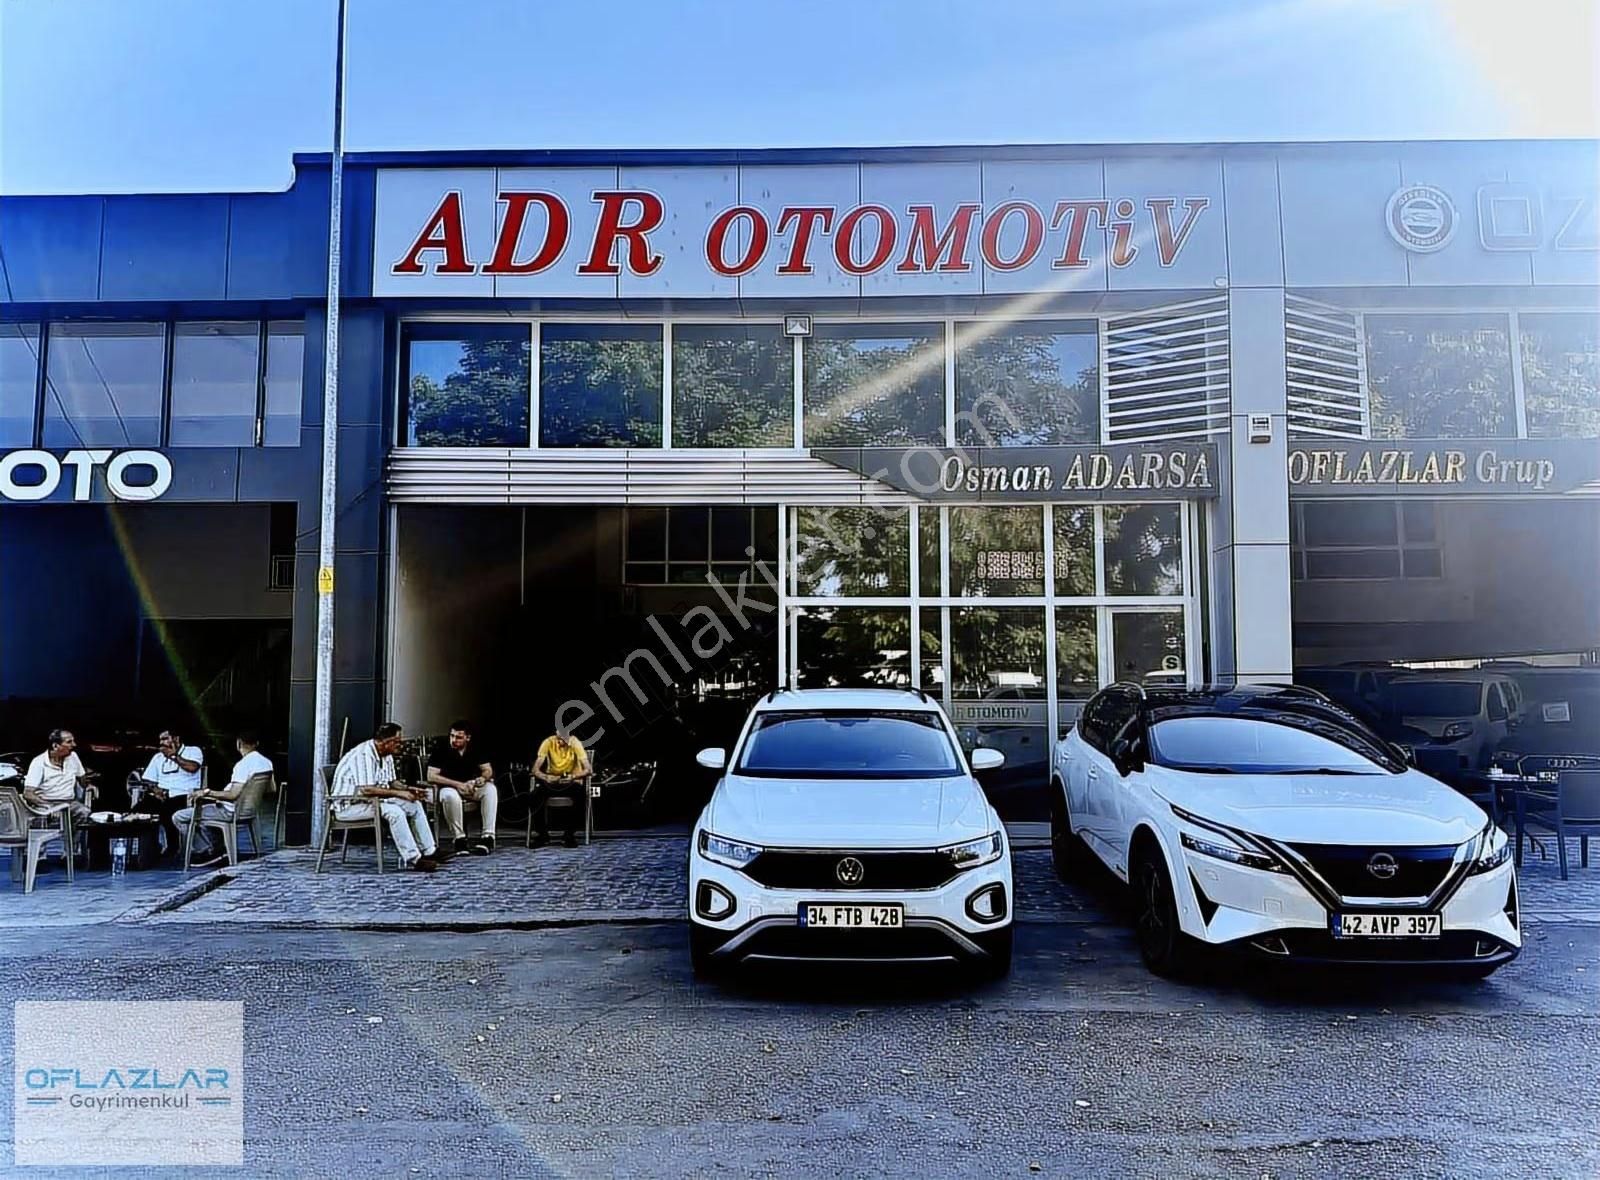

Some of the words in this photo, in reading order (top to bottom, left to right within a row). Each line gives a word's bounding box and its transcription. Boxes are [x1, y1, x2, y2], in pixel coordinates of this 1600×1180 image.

[391, 189, 665, 277] ADR
[0, 449, 172, 501] OTO
[940, 456, 1053, 492] Osman
[1062, 452, 1212, 490] ADARSA
[1288, 450, 1466, 484] OFLAZLAR
[1475, 450, 1555, 489] Grup
[808, 907, 828, 926] 34
[834, 907, 862, 926] FTB
[870, 907, 899, 926] 428
[1342, 916, 1363, 934] 42
[1371, 916, 1400, 934] AVP
[1408, 916, 1437, 934] 397
